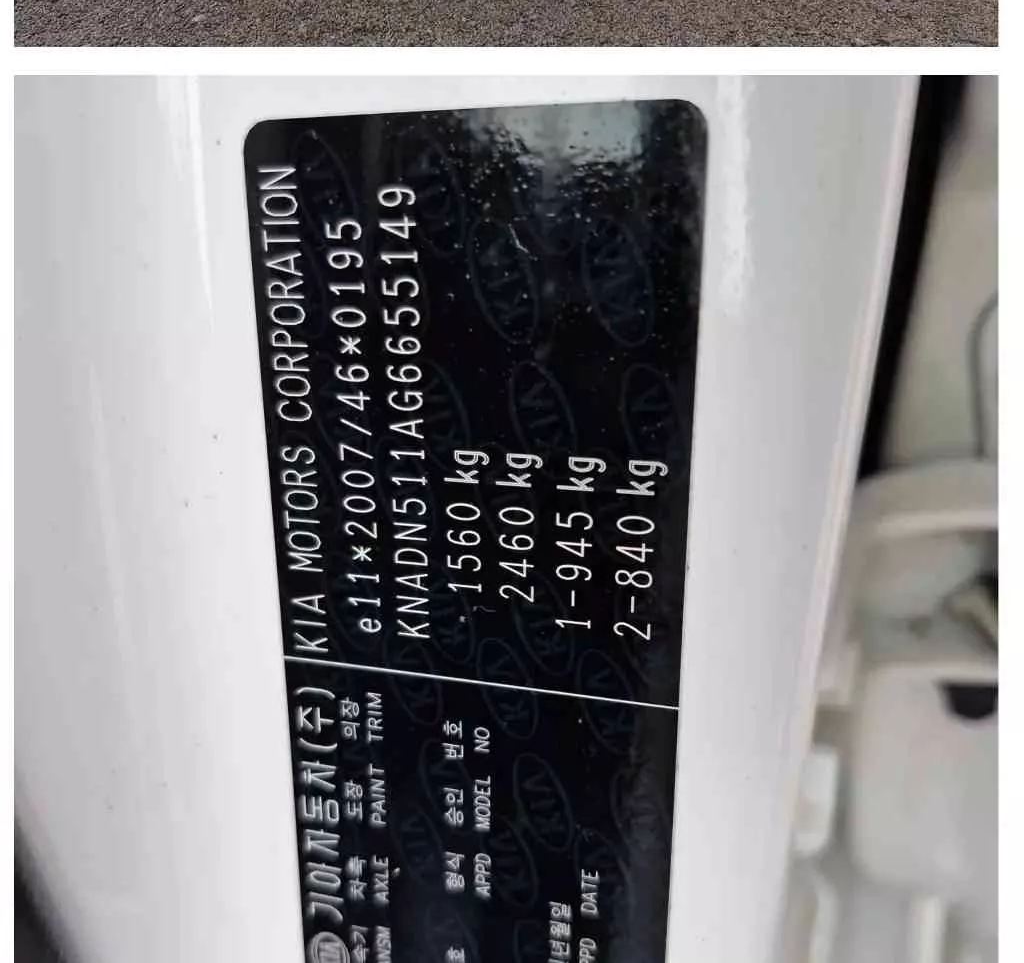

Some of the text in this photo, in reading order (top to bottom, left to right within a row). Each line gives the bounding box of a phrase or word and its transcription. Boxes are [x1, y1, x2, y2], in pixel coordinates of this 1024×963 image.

[257, 166, 328, 652] KIA MOTORS CORPORATION
[377, 187, 430, 638] KNADN511AG6655149
[444, 449, 490, 593] 1560 kg
[495, 453, 543, 603] 2460 kg
[555, 456, 607, 629] 1-945 kg
[613, 459, 668, 640] 2-840 kg
[366, 692, 384, 742] TRIM
[442, 721, 464, 759] 번호
[296, 687, 343, 925] 기아자동차(주)
[367, 763, 387, 825] PAINT
[443, 788, 465, 826] 승인
[473, 726, 492, 898] APPD MODEL NO
[373, 855, 389, 904] AXLE
[580, 869, 600, 916] DATE
